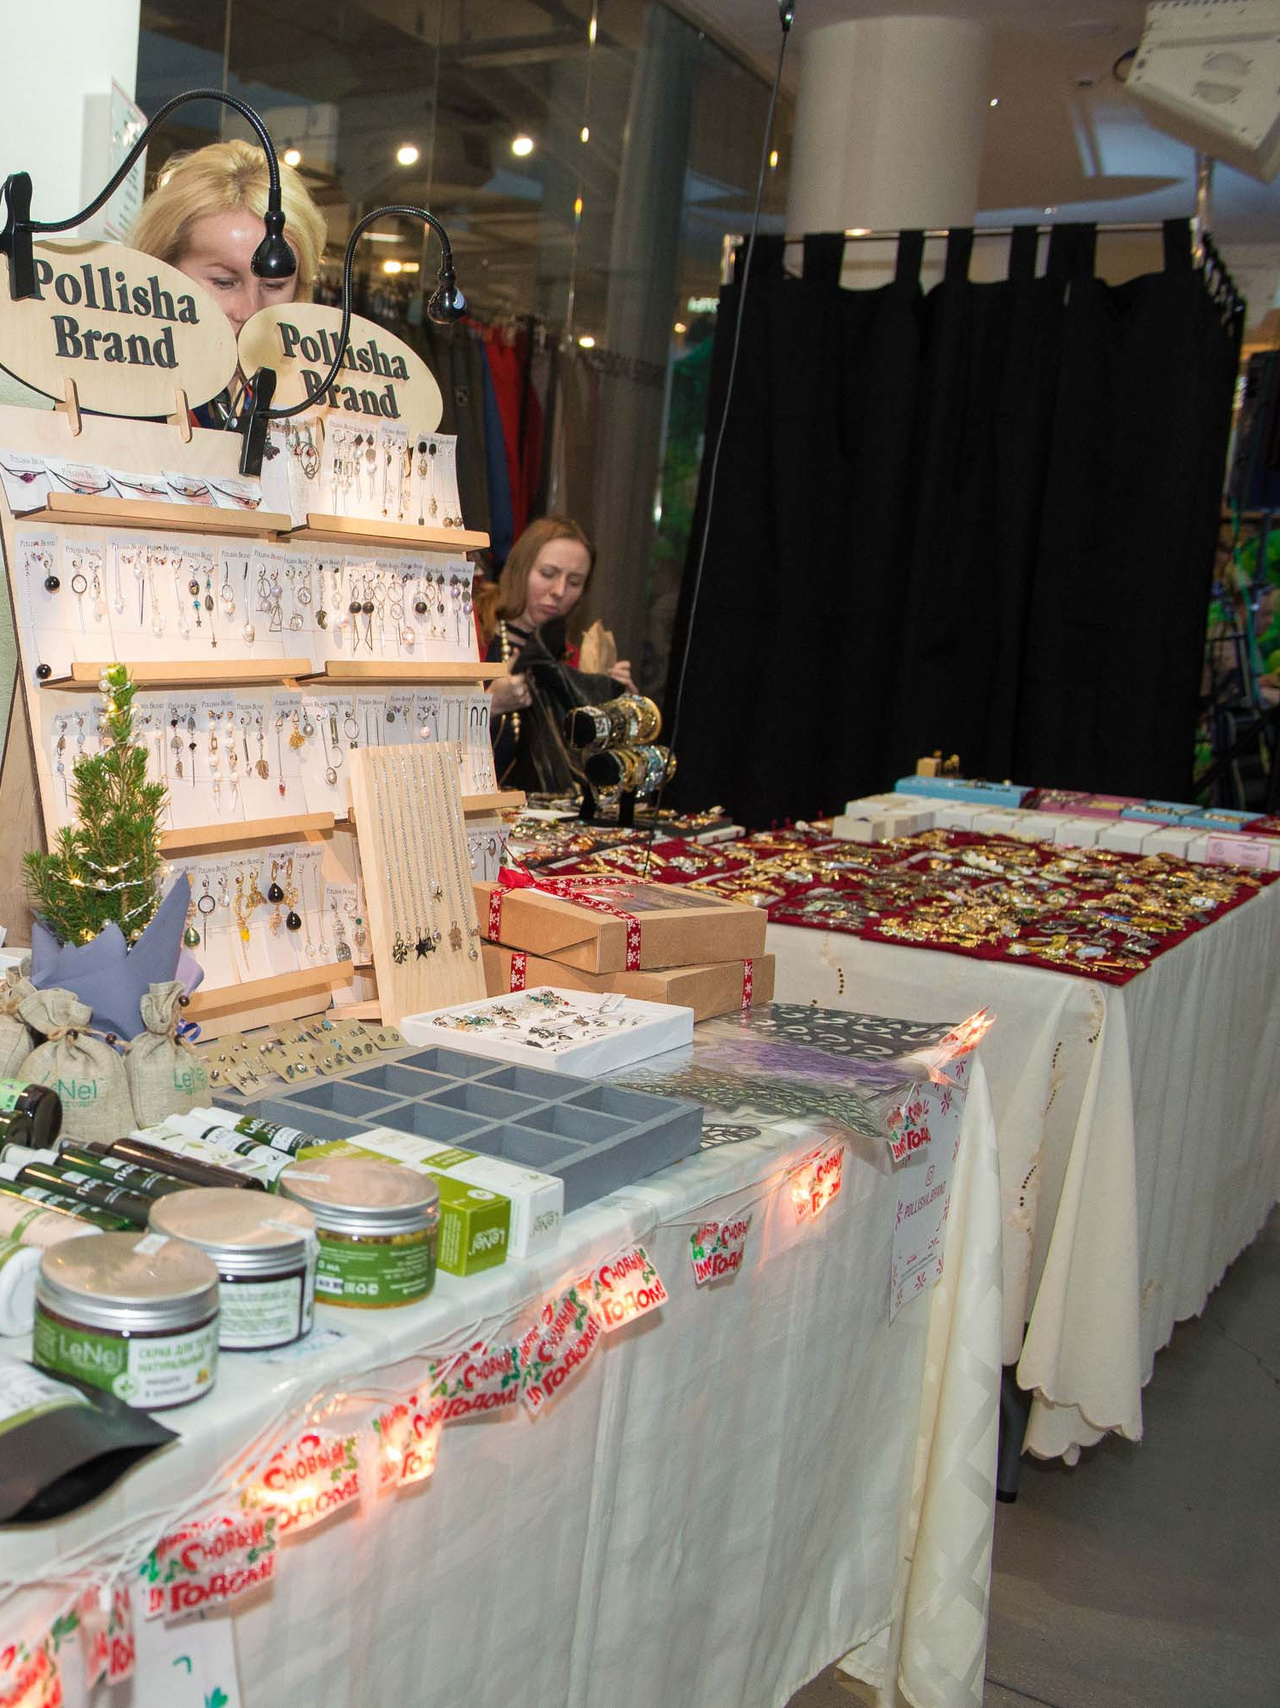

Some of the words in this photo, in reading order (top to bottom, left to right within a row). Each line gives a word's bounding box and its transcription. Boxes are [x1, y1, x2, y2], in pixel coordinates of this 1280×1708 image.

[31, 257, 200, 324] Pollisha
[50, 315, 179, 370] Brand
[277, 322, 410, 381] Pollisha
[300, 369, 401, 419] Brand
